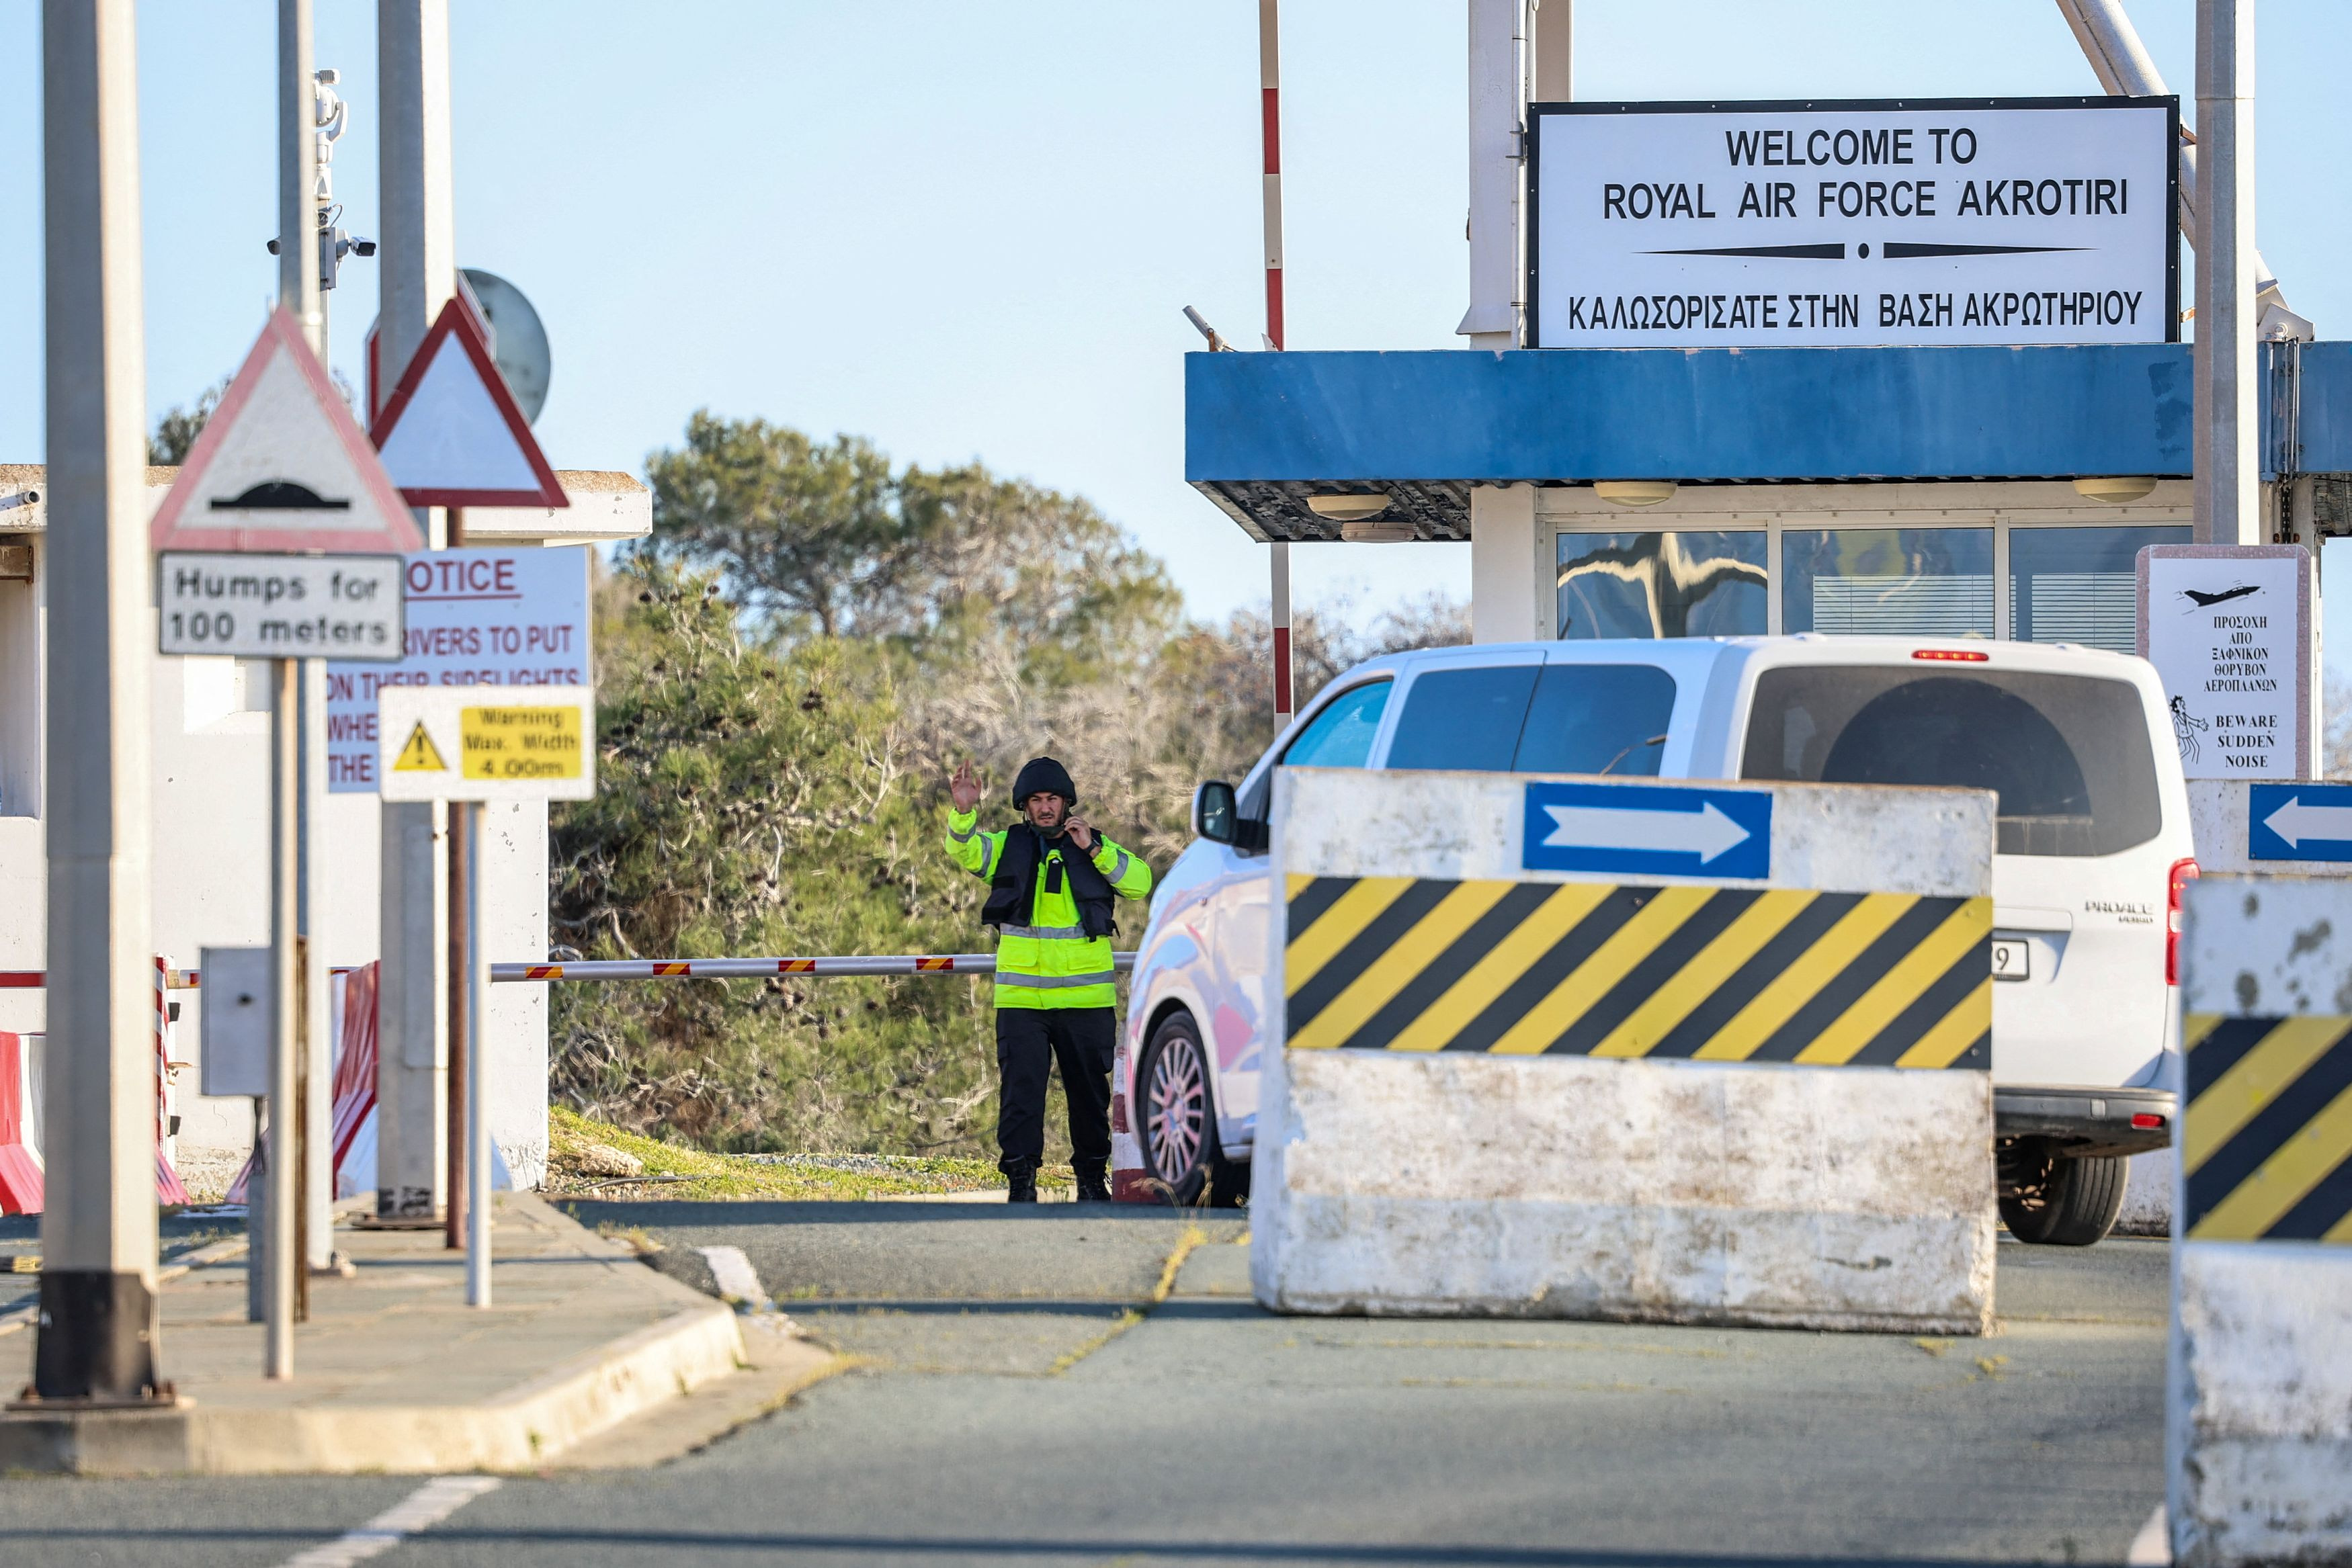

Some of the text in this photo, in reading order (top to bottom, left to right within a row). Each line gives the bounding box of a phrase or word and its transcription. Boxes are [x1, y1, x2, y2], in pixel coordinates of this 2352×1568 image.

[1725, 128, 1978, 166] WELCOME TO
[1603, 179, 2128, 220] ROYAL AIR FORCE AKROTIRI
[1568, 290, 2143, 330] ΚΑΛΩΣΟΡΙΣΑΤΕ ΣΤΗΝ ΒΑΣΗ ΑΚΡΩΤΗΡΙΟΥ
[175, 568, 378, 606] Humps for
[406, 560, 515, 592] OTICE
[172, 611, 387, 643] 100 meters
[2214, 616, 2267, 629] ΠΡΟΣΟΧΗ
[403, 625, 573, 656] IVERS TO PUT
[2229, 631, 2253, 645] ΑΠΟ
[2212, 647, 2269, 660] ΞΑΦΝΙΚΟΝ
[2214, 662, 2267, 677] ΘΟΡΥΒΟΝ
[327, 672, 353, 701] ON
[2204, 679, 2277, 693] ΑΕΡΟΠΛΑΝΩΝ
[329, 713, 378, 742] WHE
[480, 708, 562, 729] Warning
[2216, 715, 2277, 728] BEWARE
[2217, 735, 2275, 748] SUDDEN
[328, 754, 374, 783] THE
[2225, 755, 2268, 768] NOISE
[1990, 946, 2010, 971] 9
